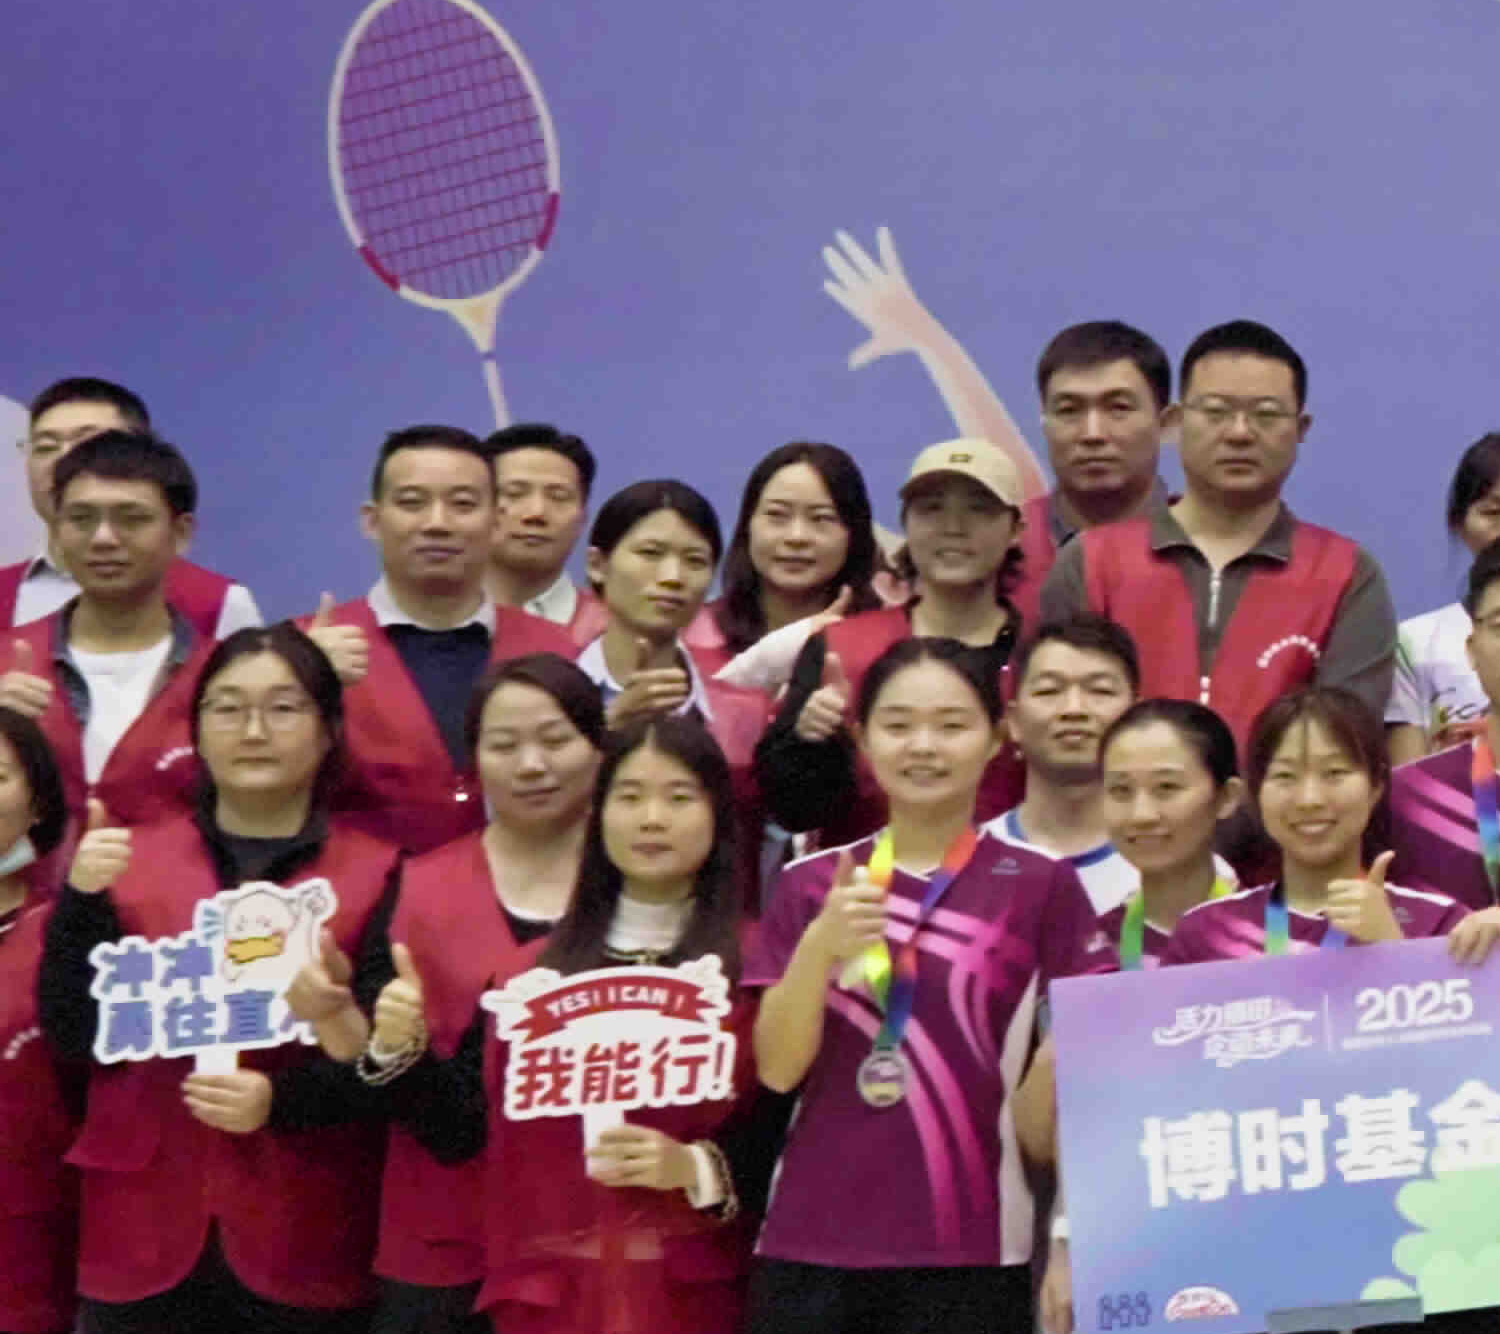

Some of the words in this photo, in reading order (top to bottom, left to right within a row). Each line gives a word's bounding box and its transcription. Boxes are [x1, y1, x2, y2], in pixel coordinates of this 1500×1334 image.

[105, 988, 293, 1054] 勇往直
[620, 985, 670, 1006] CAN
[1354, 978, 1474, 1033] 2025
[514, 1034, 726, 1111] 我能行!
